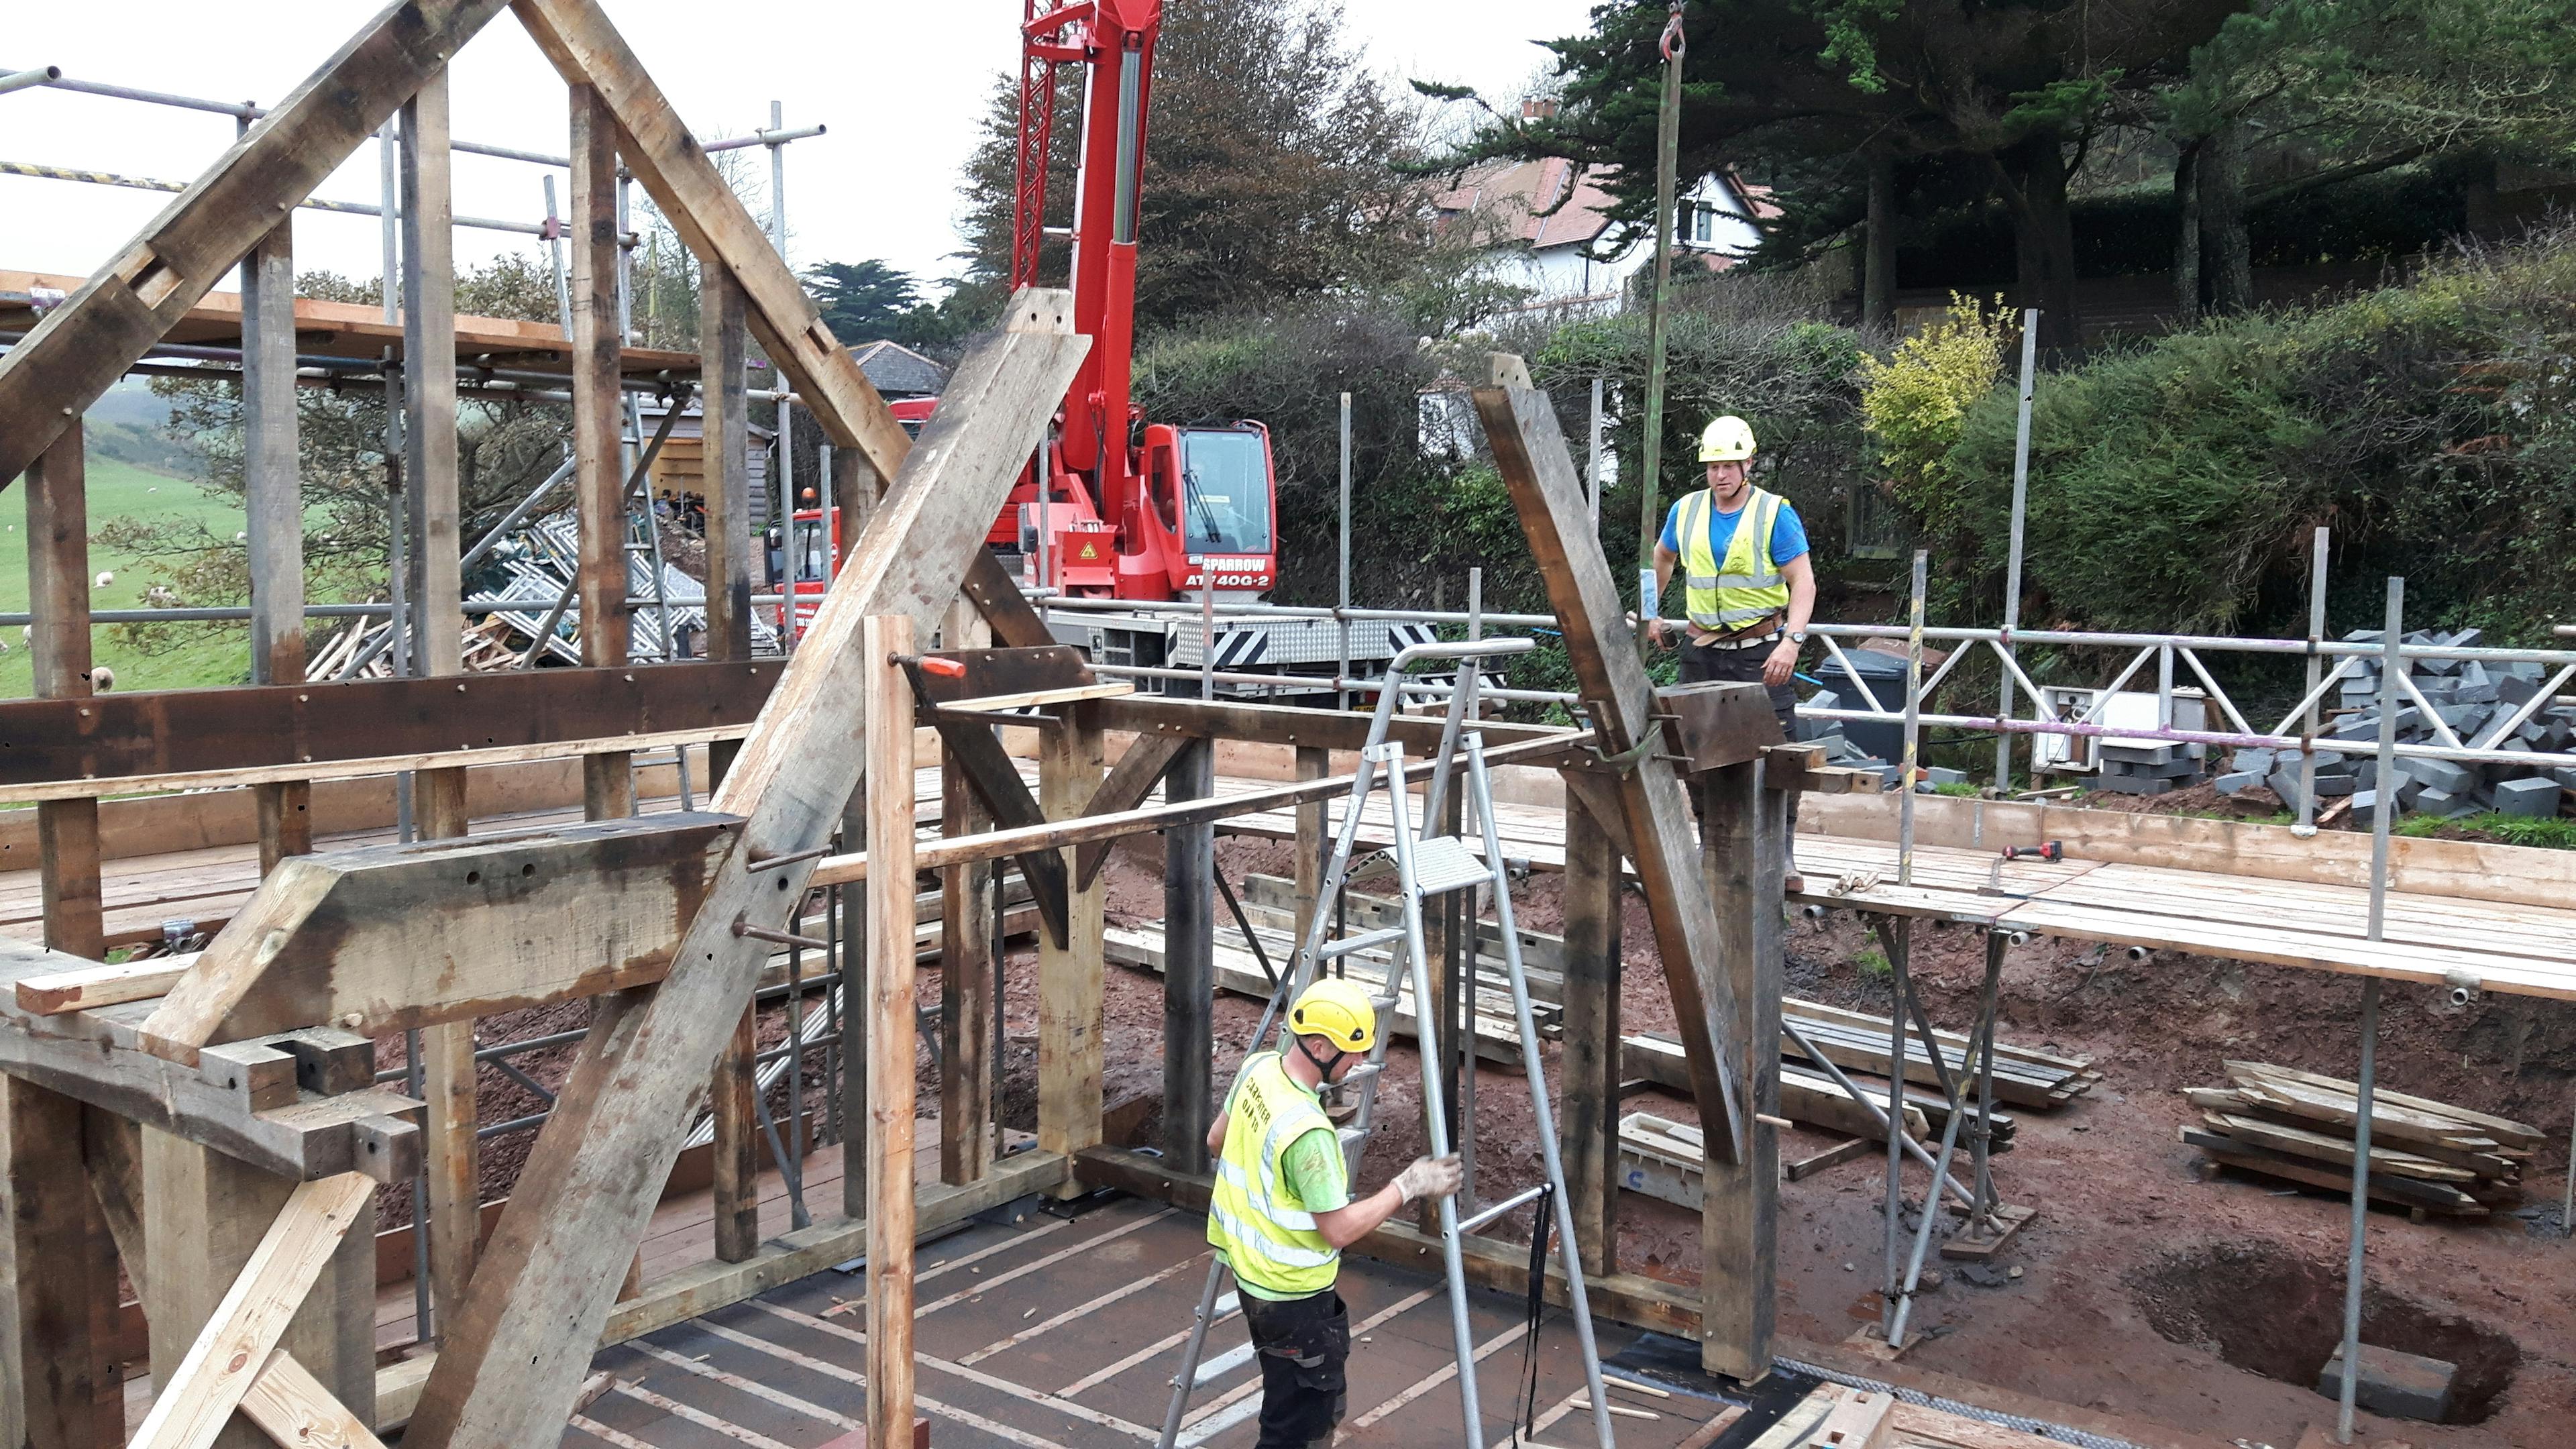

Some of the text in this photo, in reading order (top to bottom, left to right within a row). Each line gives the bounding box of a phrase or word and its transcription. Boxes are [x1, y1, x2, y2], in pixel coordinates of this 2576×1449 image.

[1202, 558, 1266, 572] SPARROW
[1185, 575, 1269, 586] AT 40G-2
